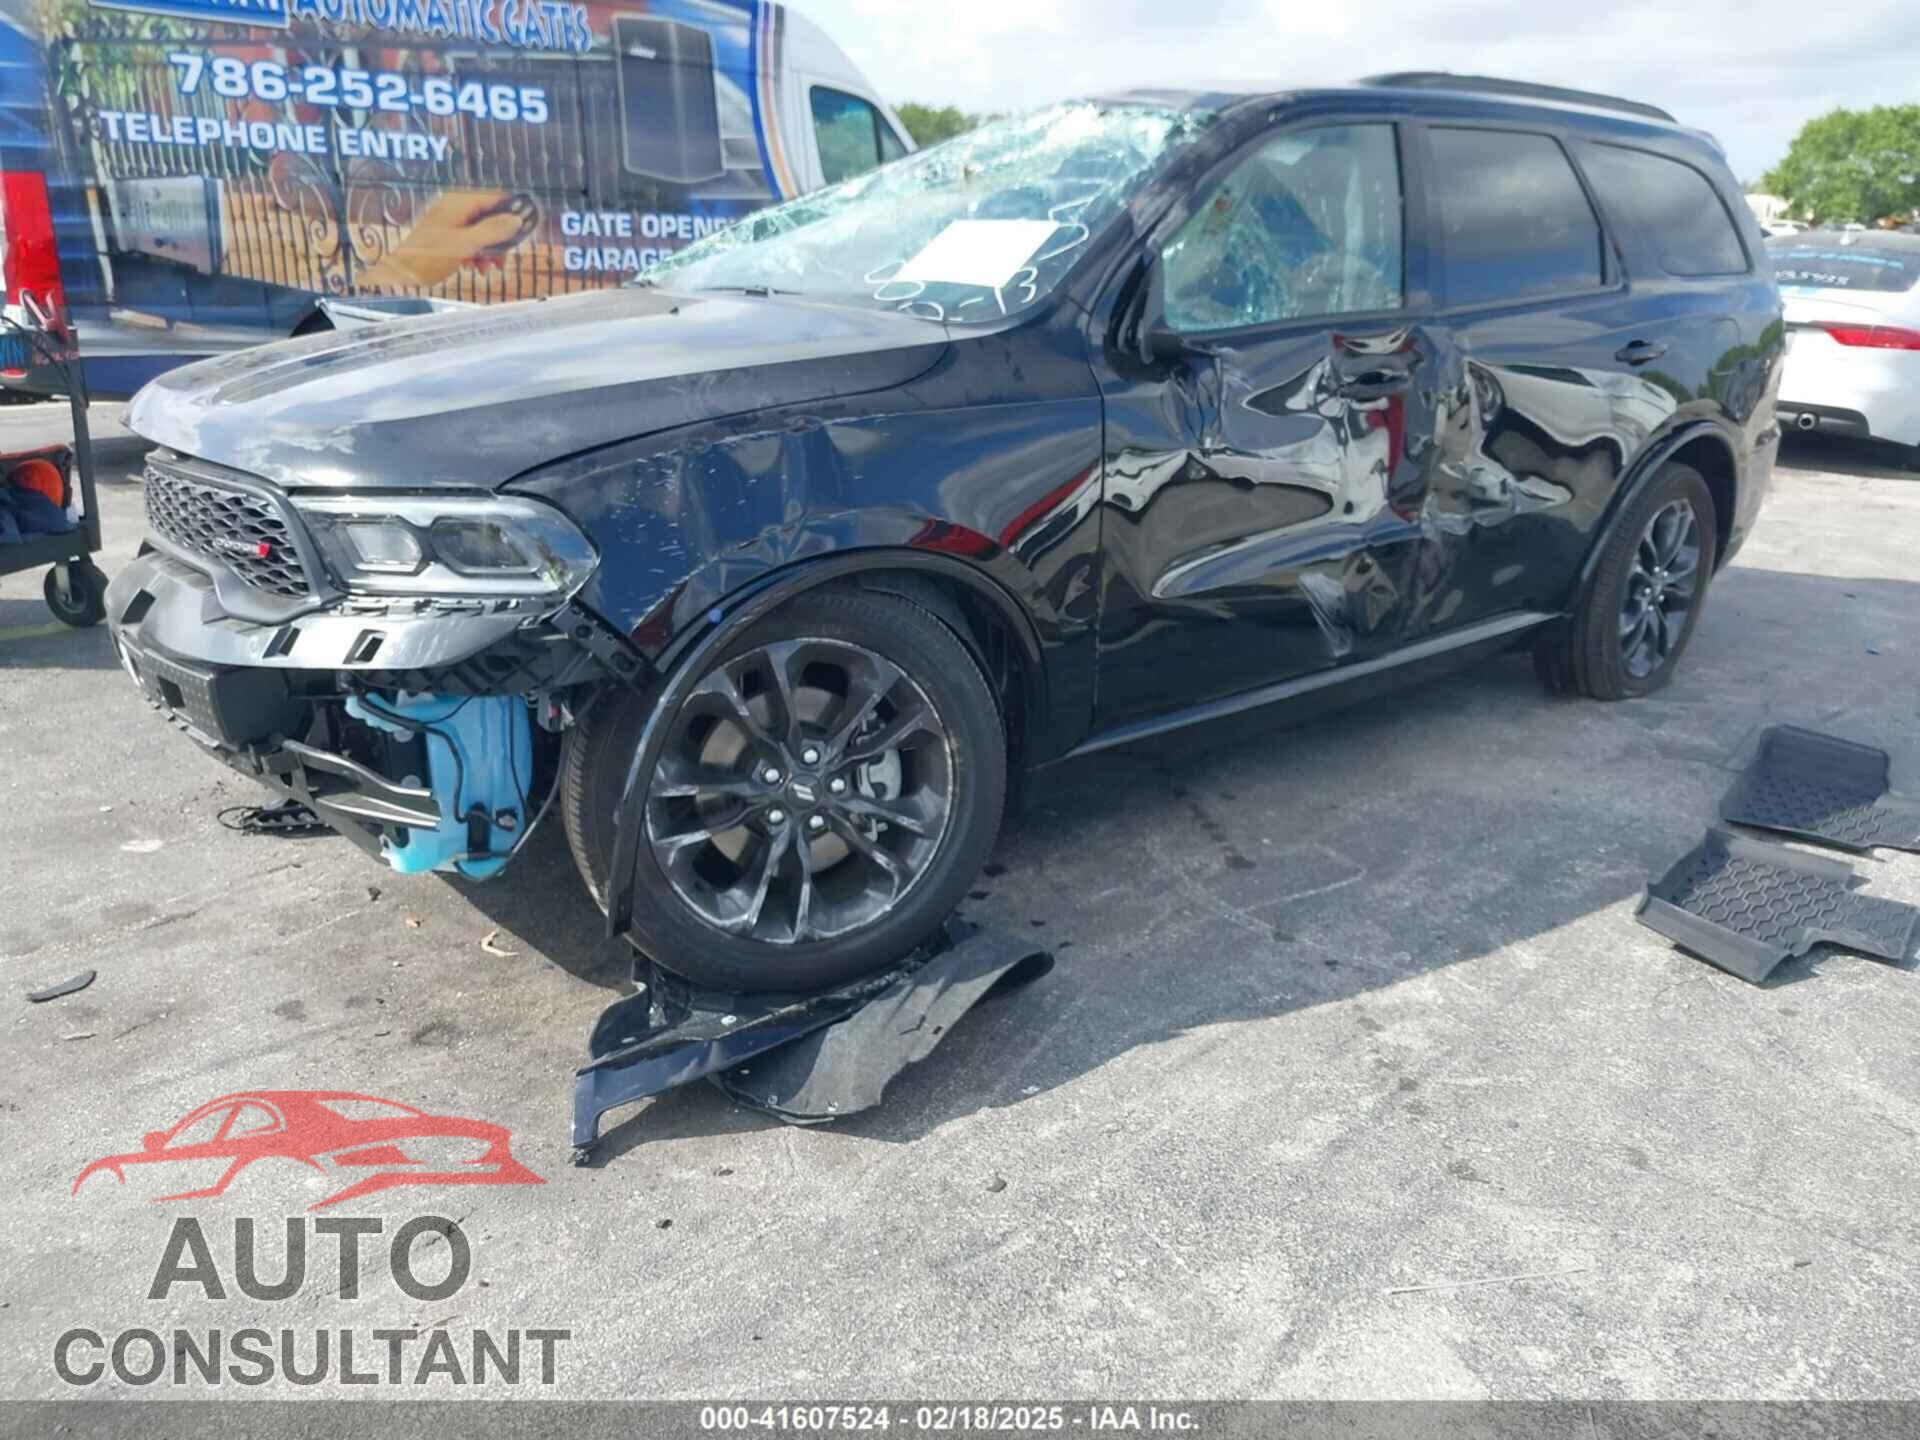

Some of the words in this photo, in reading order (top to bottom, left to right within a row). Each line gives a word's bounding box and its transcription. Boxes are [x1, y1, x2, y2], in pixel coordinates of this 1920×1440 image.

[169, 53, 548, 124] 786-252-6465
[99, 110, 328, 153] TELEPHONE
[339, 128, 449, 162] ENTRY
[561, 212, 632, 238] GATE
[640, 213, 736, 240] OPEN
